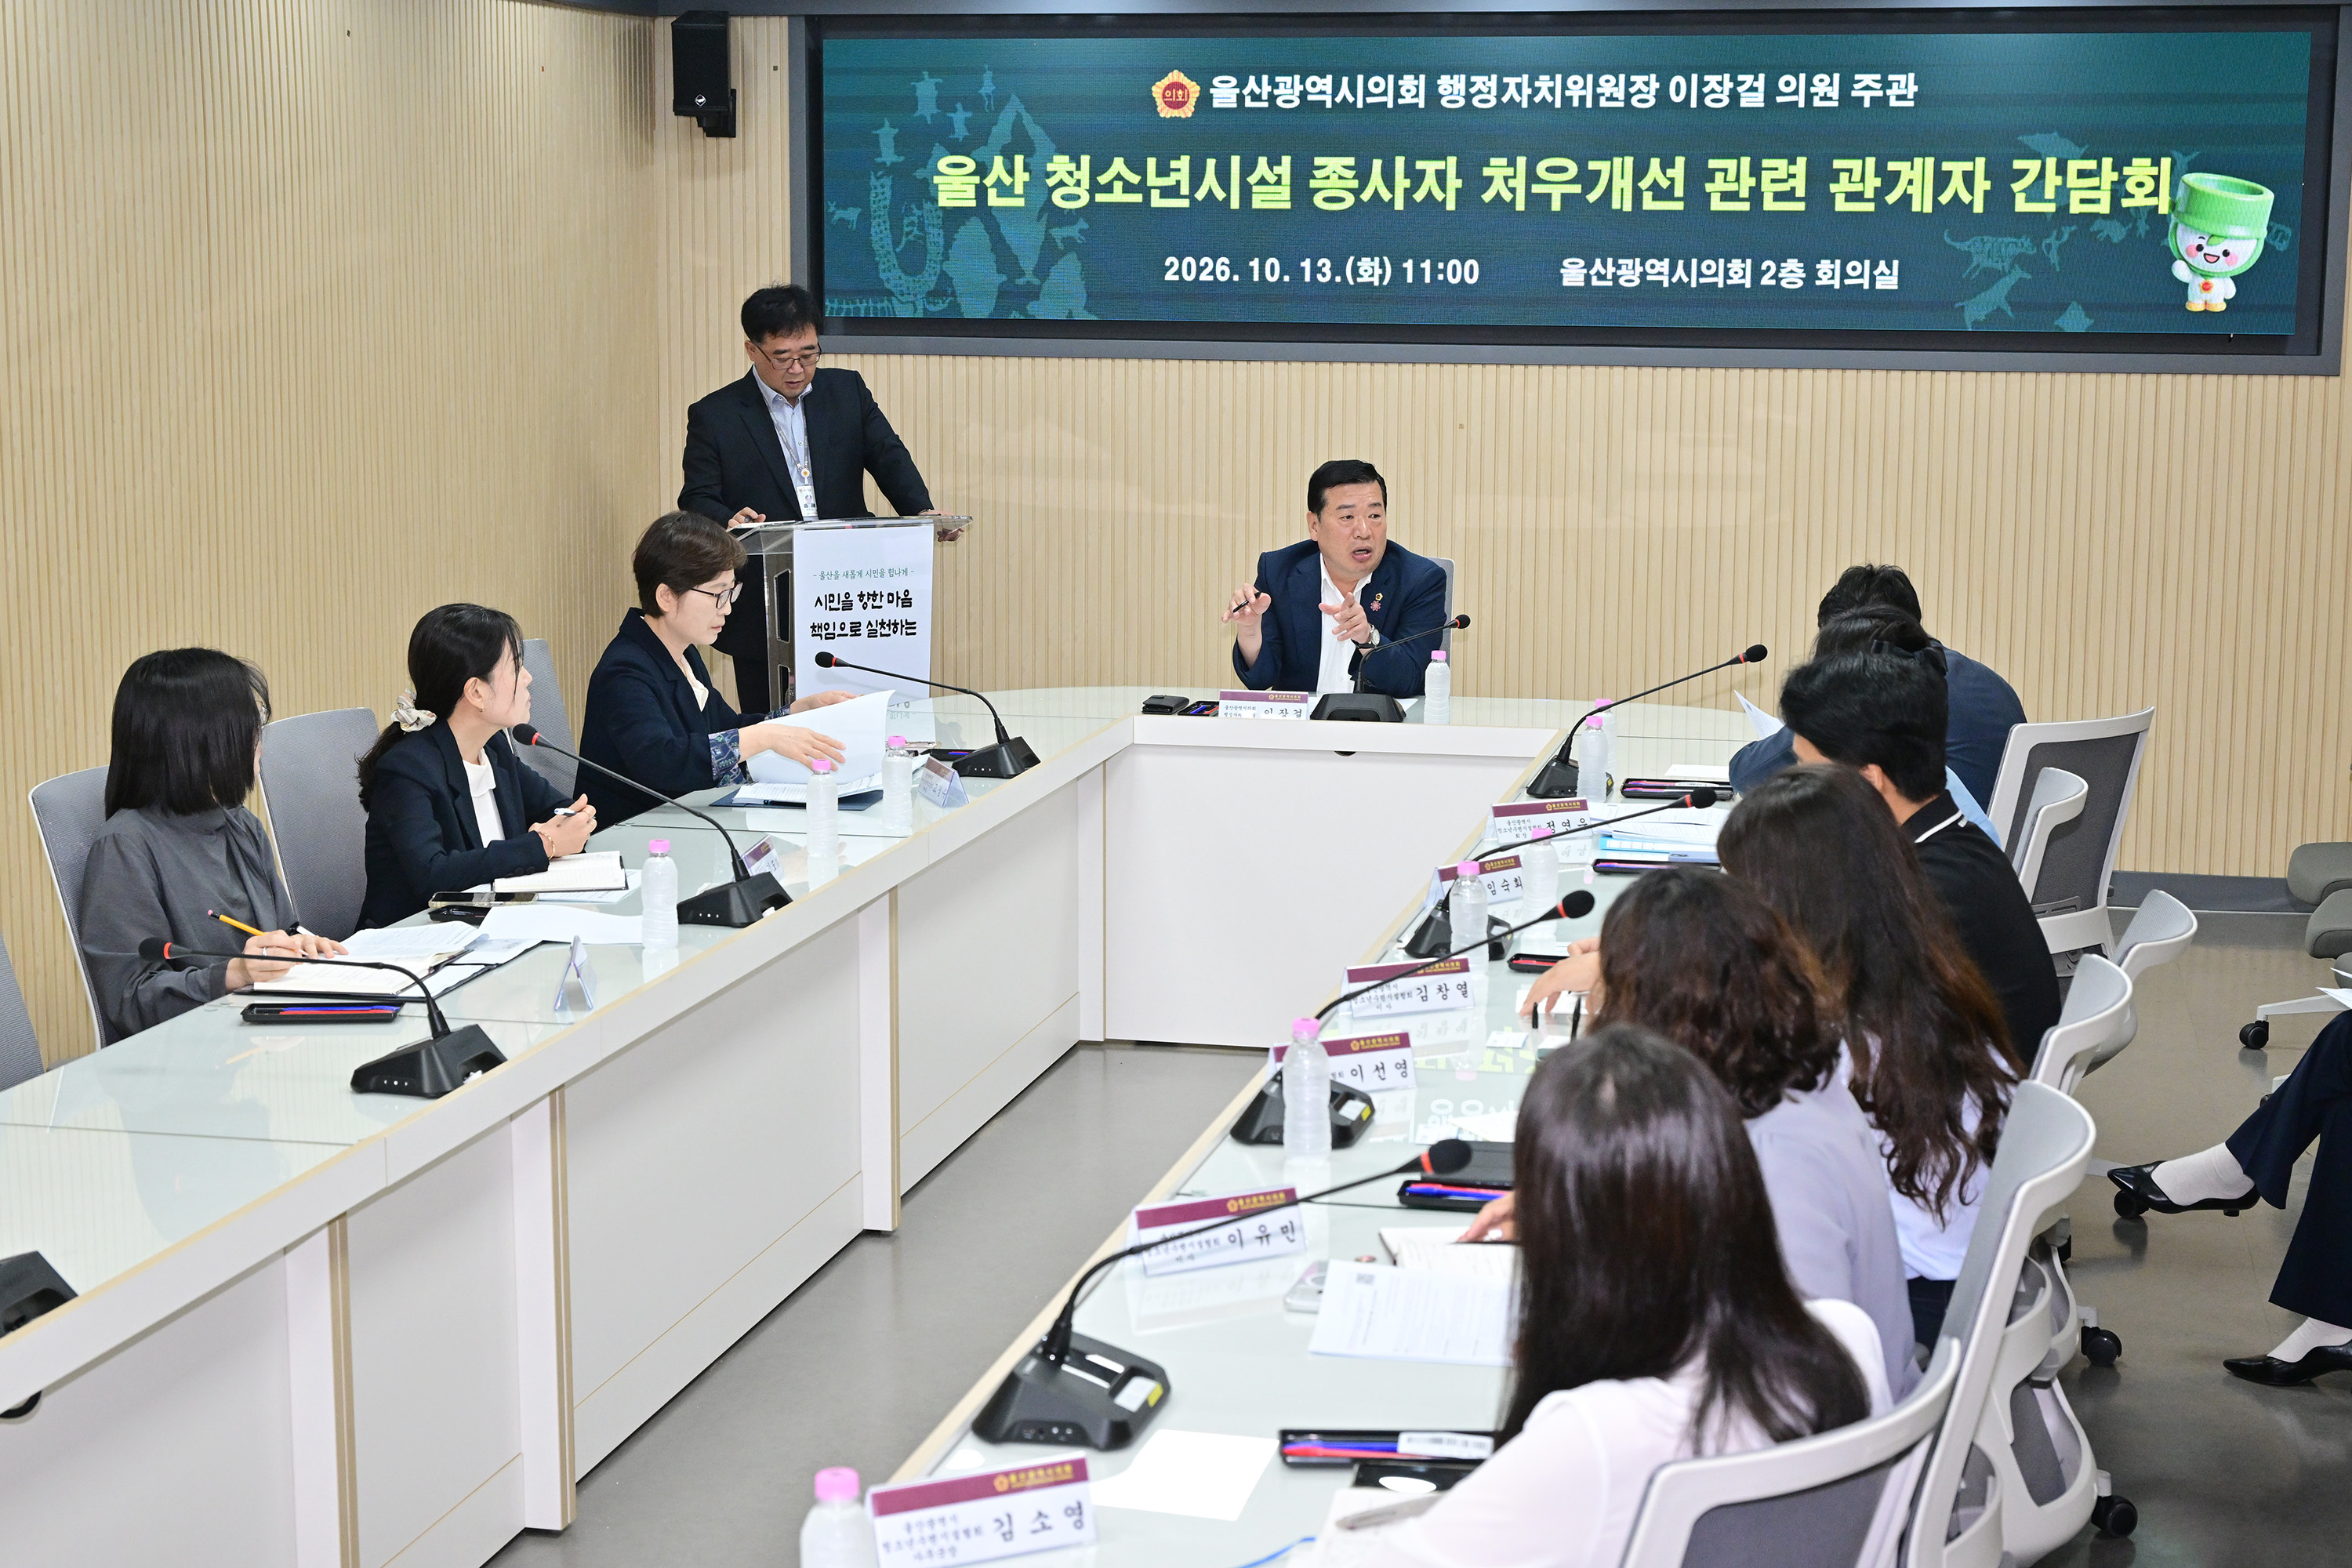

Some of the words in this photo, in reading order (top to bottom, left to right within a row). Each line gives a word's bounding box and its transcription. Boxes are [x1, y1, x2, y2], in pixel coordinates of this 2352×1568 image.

[1163, 88, 1189, 102] 의회
[1209, 74, 1426, 109] 울산광역시의회
[1436, 73, 1660, 109] 행정자치위원장
[1669, 73, 1766, 108] 이장걸
[1775, 72, 1840, 108] 의원
[1850, 72, 1918, 108] 주관
[933, 154, 1030, 208] 울산
[1045, 154, 1292, 209] 청소년시설
[1309, 155, 1463, 211] 종사자
[1481, 155, 1686, 212] 처우개선
[1704, 156, 1807, 212] 관련
[1829, 156, 1991, 213] 관계자
[2010, 156, 2172, 215] 간담회
[1164, 256, 1240, 281] 2026.
[1249, 257, 1290, 282] 10.
[1300, 256, 1392, 286] 13.(화)
[1403, 259, 1479, 285] 11:00
[1559, 257, 1752, 289] 울산광역시의회
[1760, 258, 1806, 289] 2층
[1815, 259, 1899, 290] 회의실
[819, 570, 840, 580] 울산을
[842, 569, 863, 579] 새롭게
[865, 568, 886, 579] 시민을
[887, 567, 909, 578] 힘나게
[814, 591, 854, 612] 시민을
[857, 590, 884, 611] 향한
[887, 589, 913, 608] 마음
[809, 621, 862, 641] 책임으로
[866, 618, 917, 639] 실천하는
[1416, 981, 1469, 1002] 김창열
[1350, 1058, 1408, 1083] 이선영
[1228, 1220, 1296, 1250] 이유민
[993, 1500, 1085, 1543] 김소영
